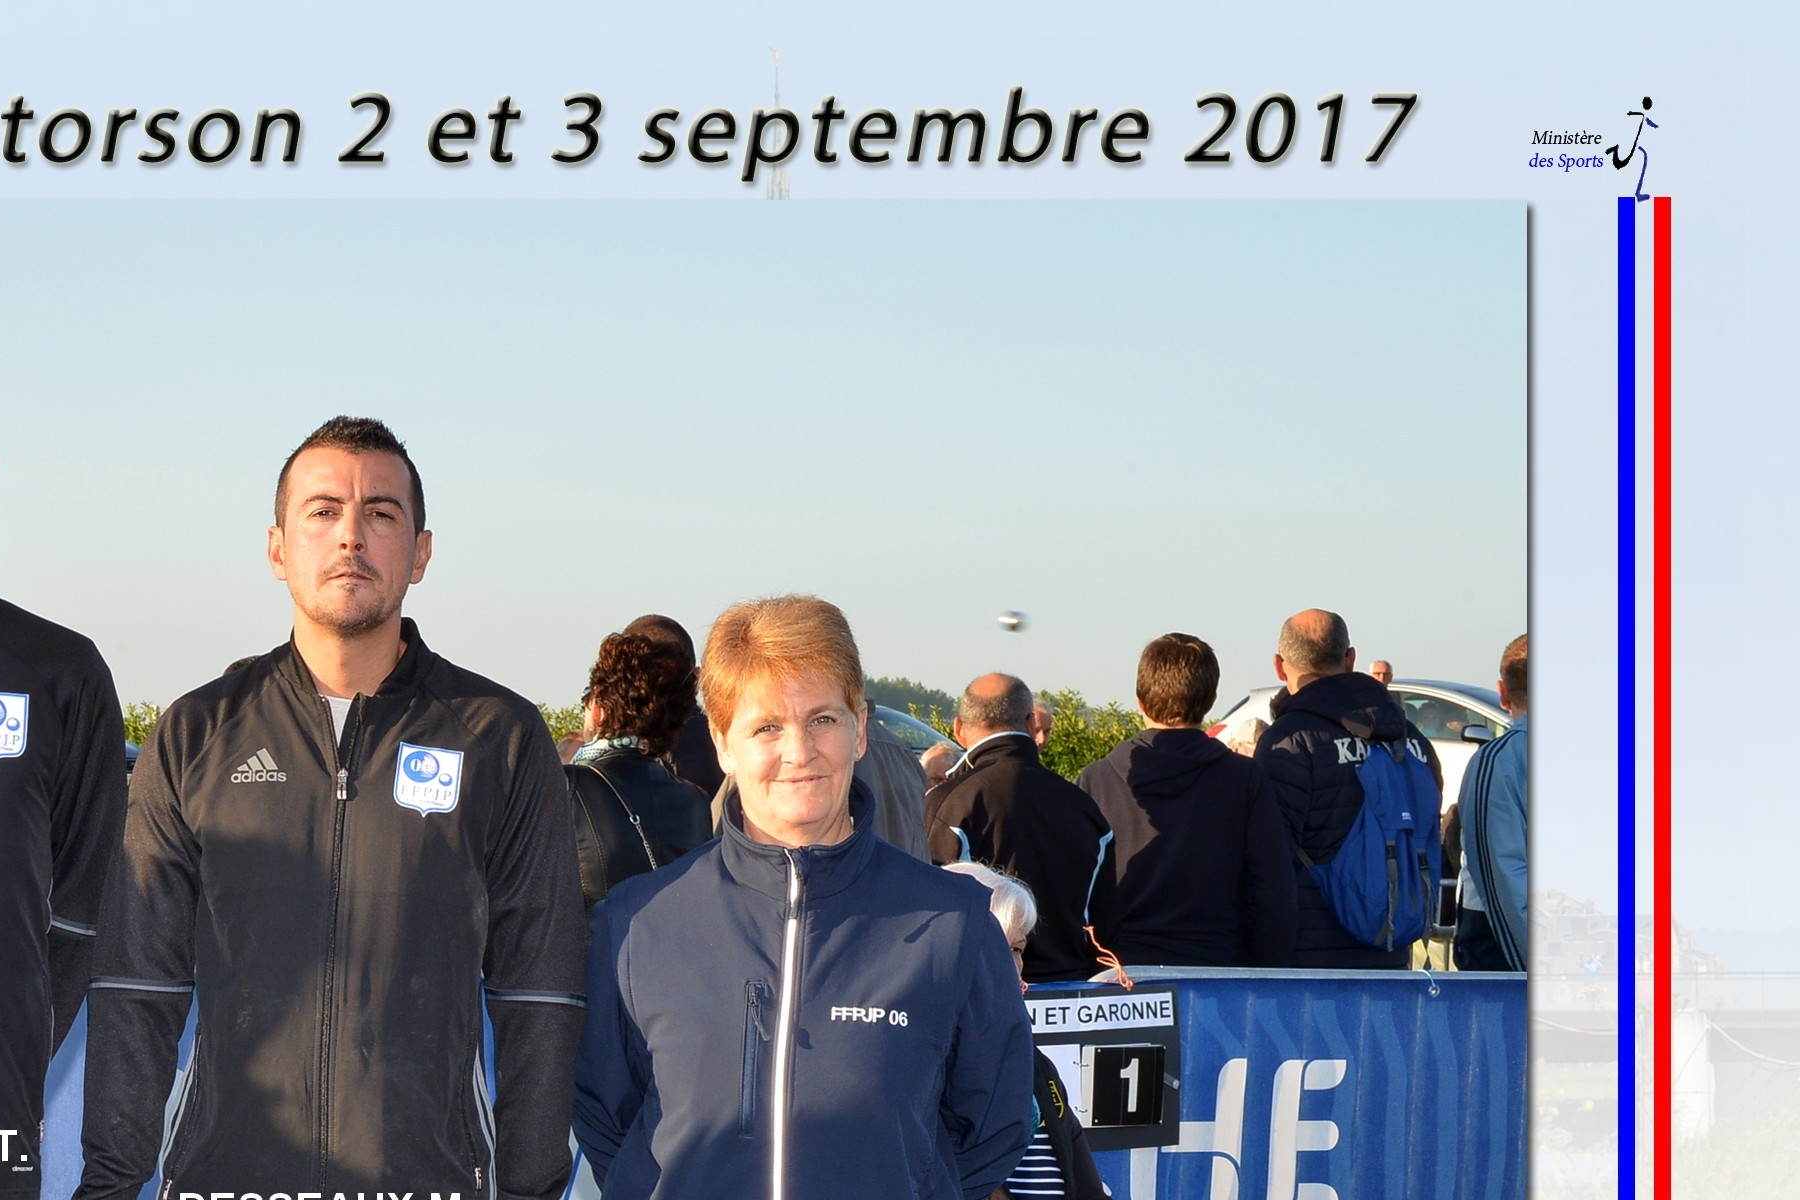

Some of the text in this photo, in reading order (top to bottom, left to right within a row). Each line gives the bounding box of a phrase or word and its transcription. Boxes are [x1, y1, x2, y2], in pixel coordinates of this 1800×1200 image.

[230, 766, 287, 783] adidas
[830, 1006, 909, 1027] FFPJP 06
[1044, 1006, 1071, 1026] ET
[1077, 1000, 1172, 1025] GARONNE
[1119, 1057, 1140, 1113] 1
